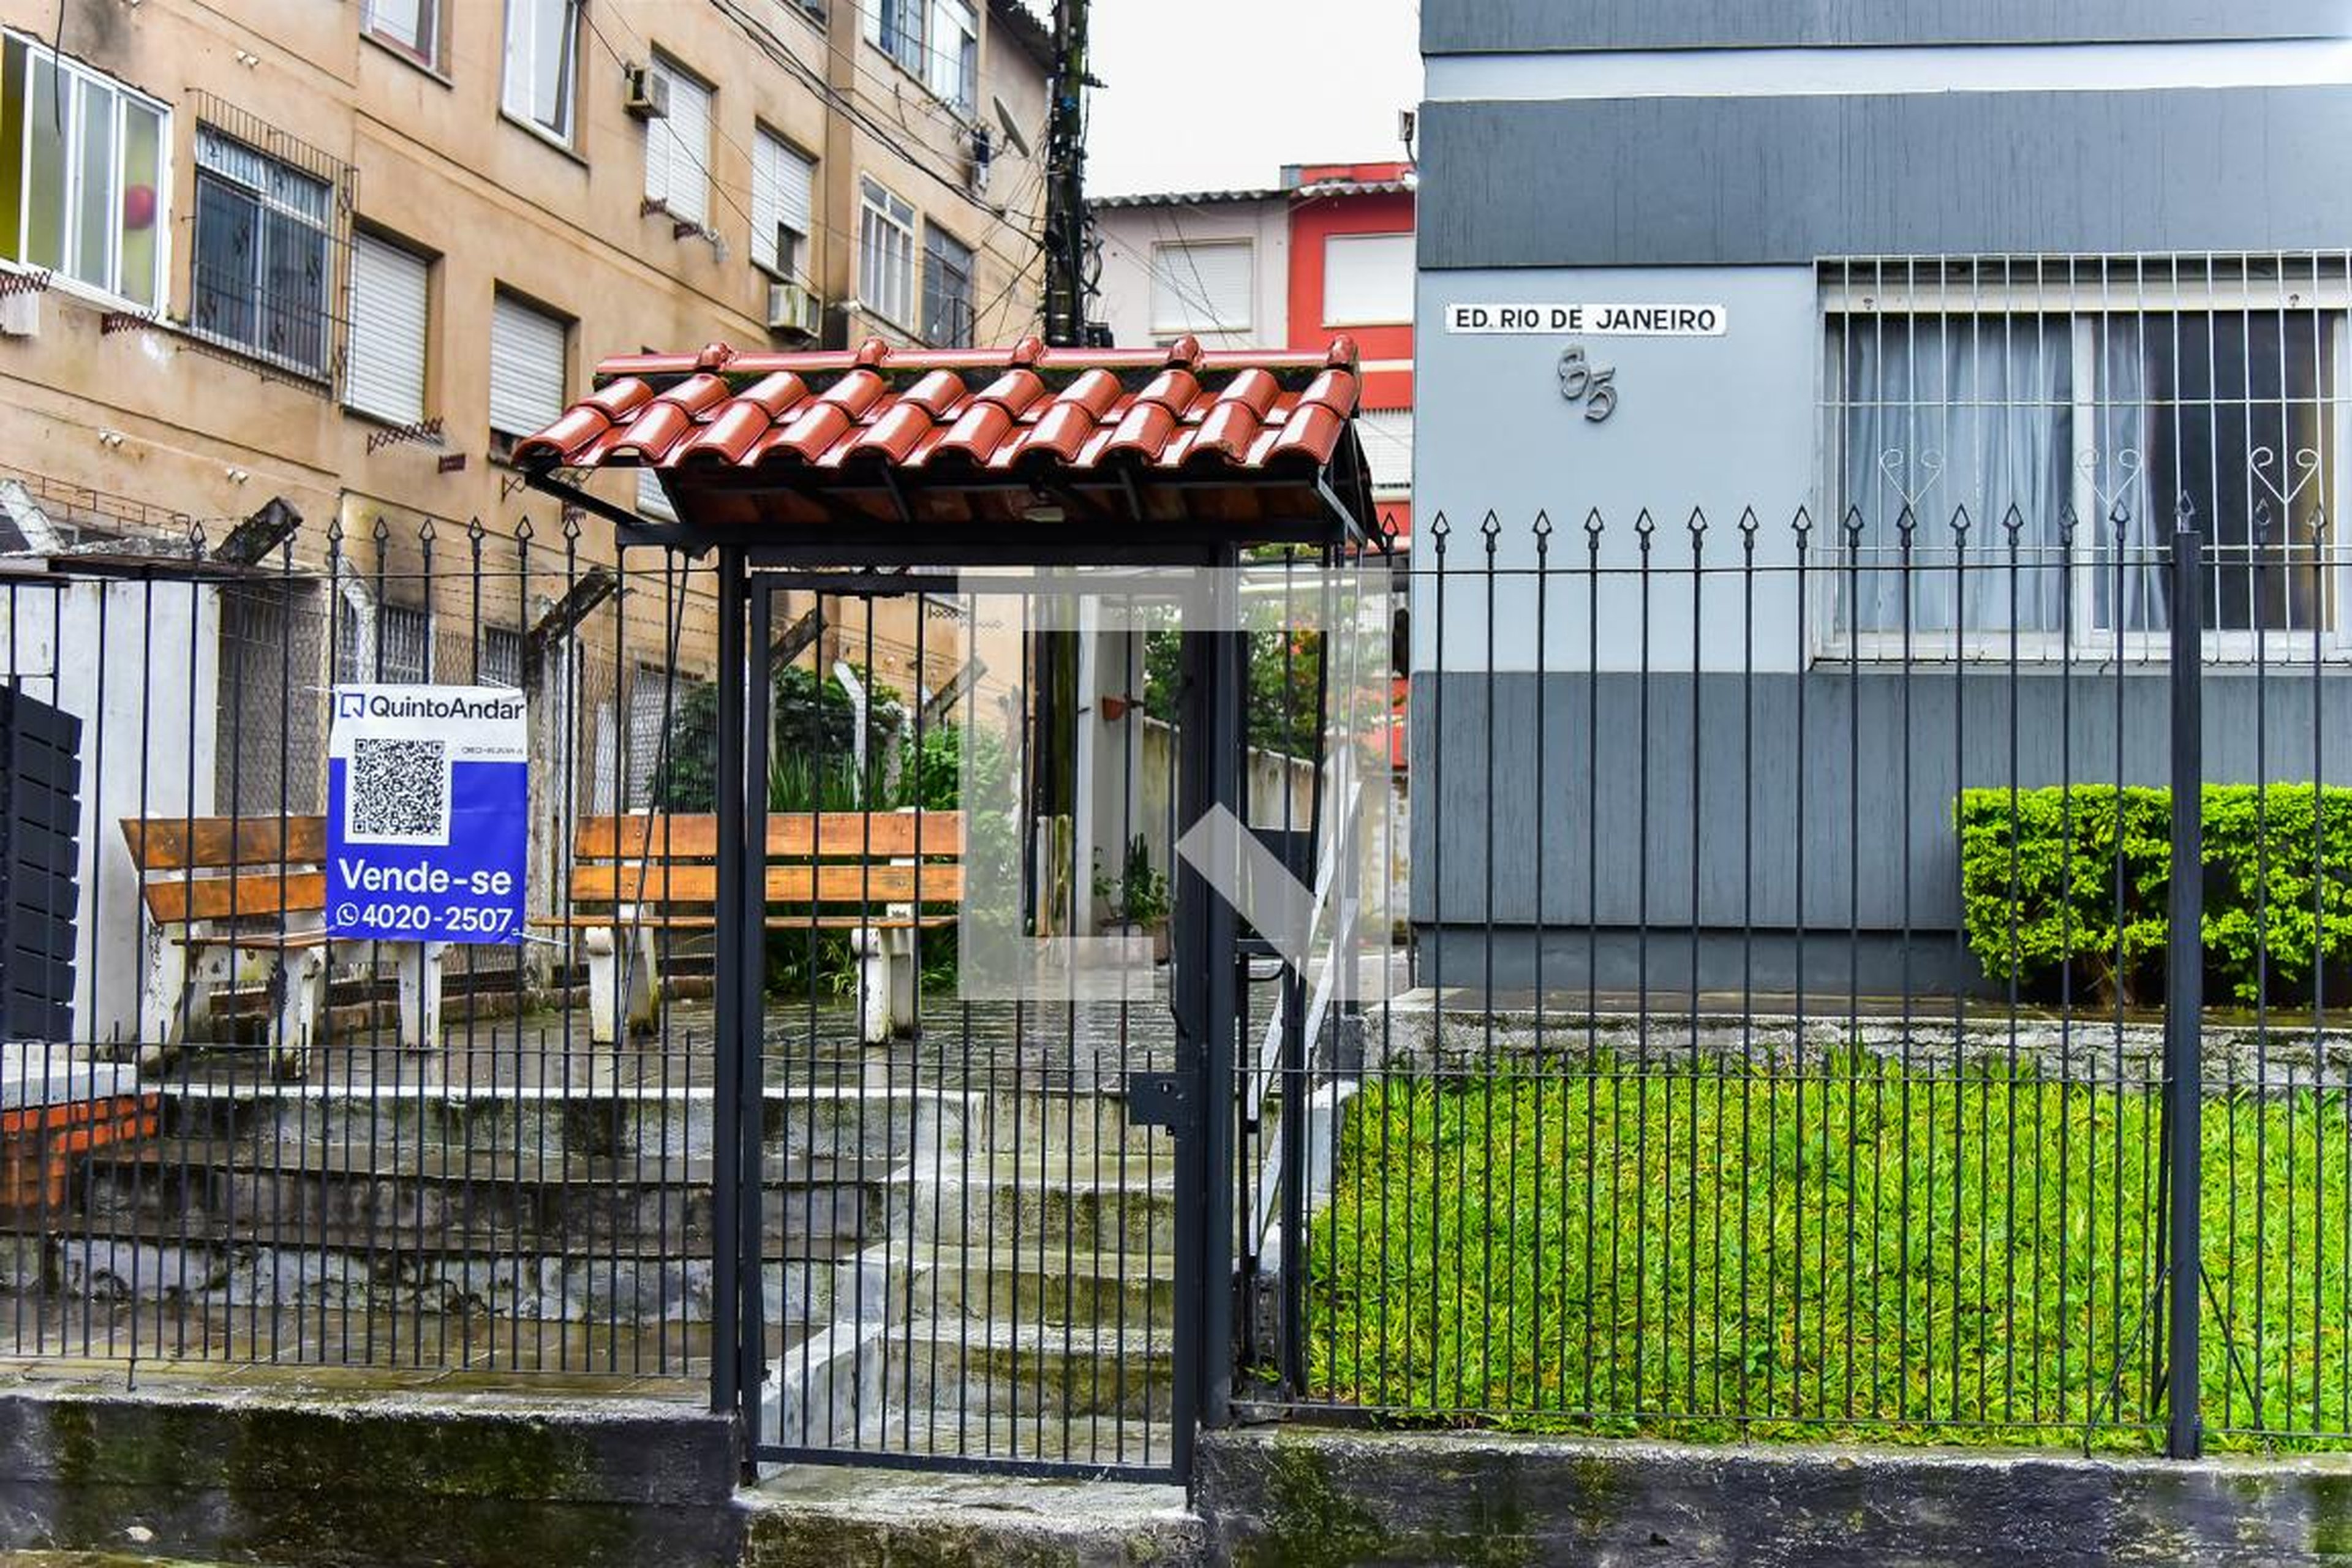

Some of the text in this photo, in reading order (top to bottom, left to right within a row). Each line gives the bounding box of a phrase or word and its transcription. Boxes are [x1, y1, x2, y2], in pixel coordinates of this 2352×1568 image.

[1551, 309, 1583, 329] DE
[1596, 309, 1716, 330] JANEIRO
[370, 695, 524, 719] QuintoAndar
[338, 858, 512, 895] Vende-se
[361, 904, 513, 932] 4020-2507
